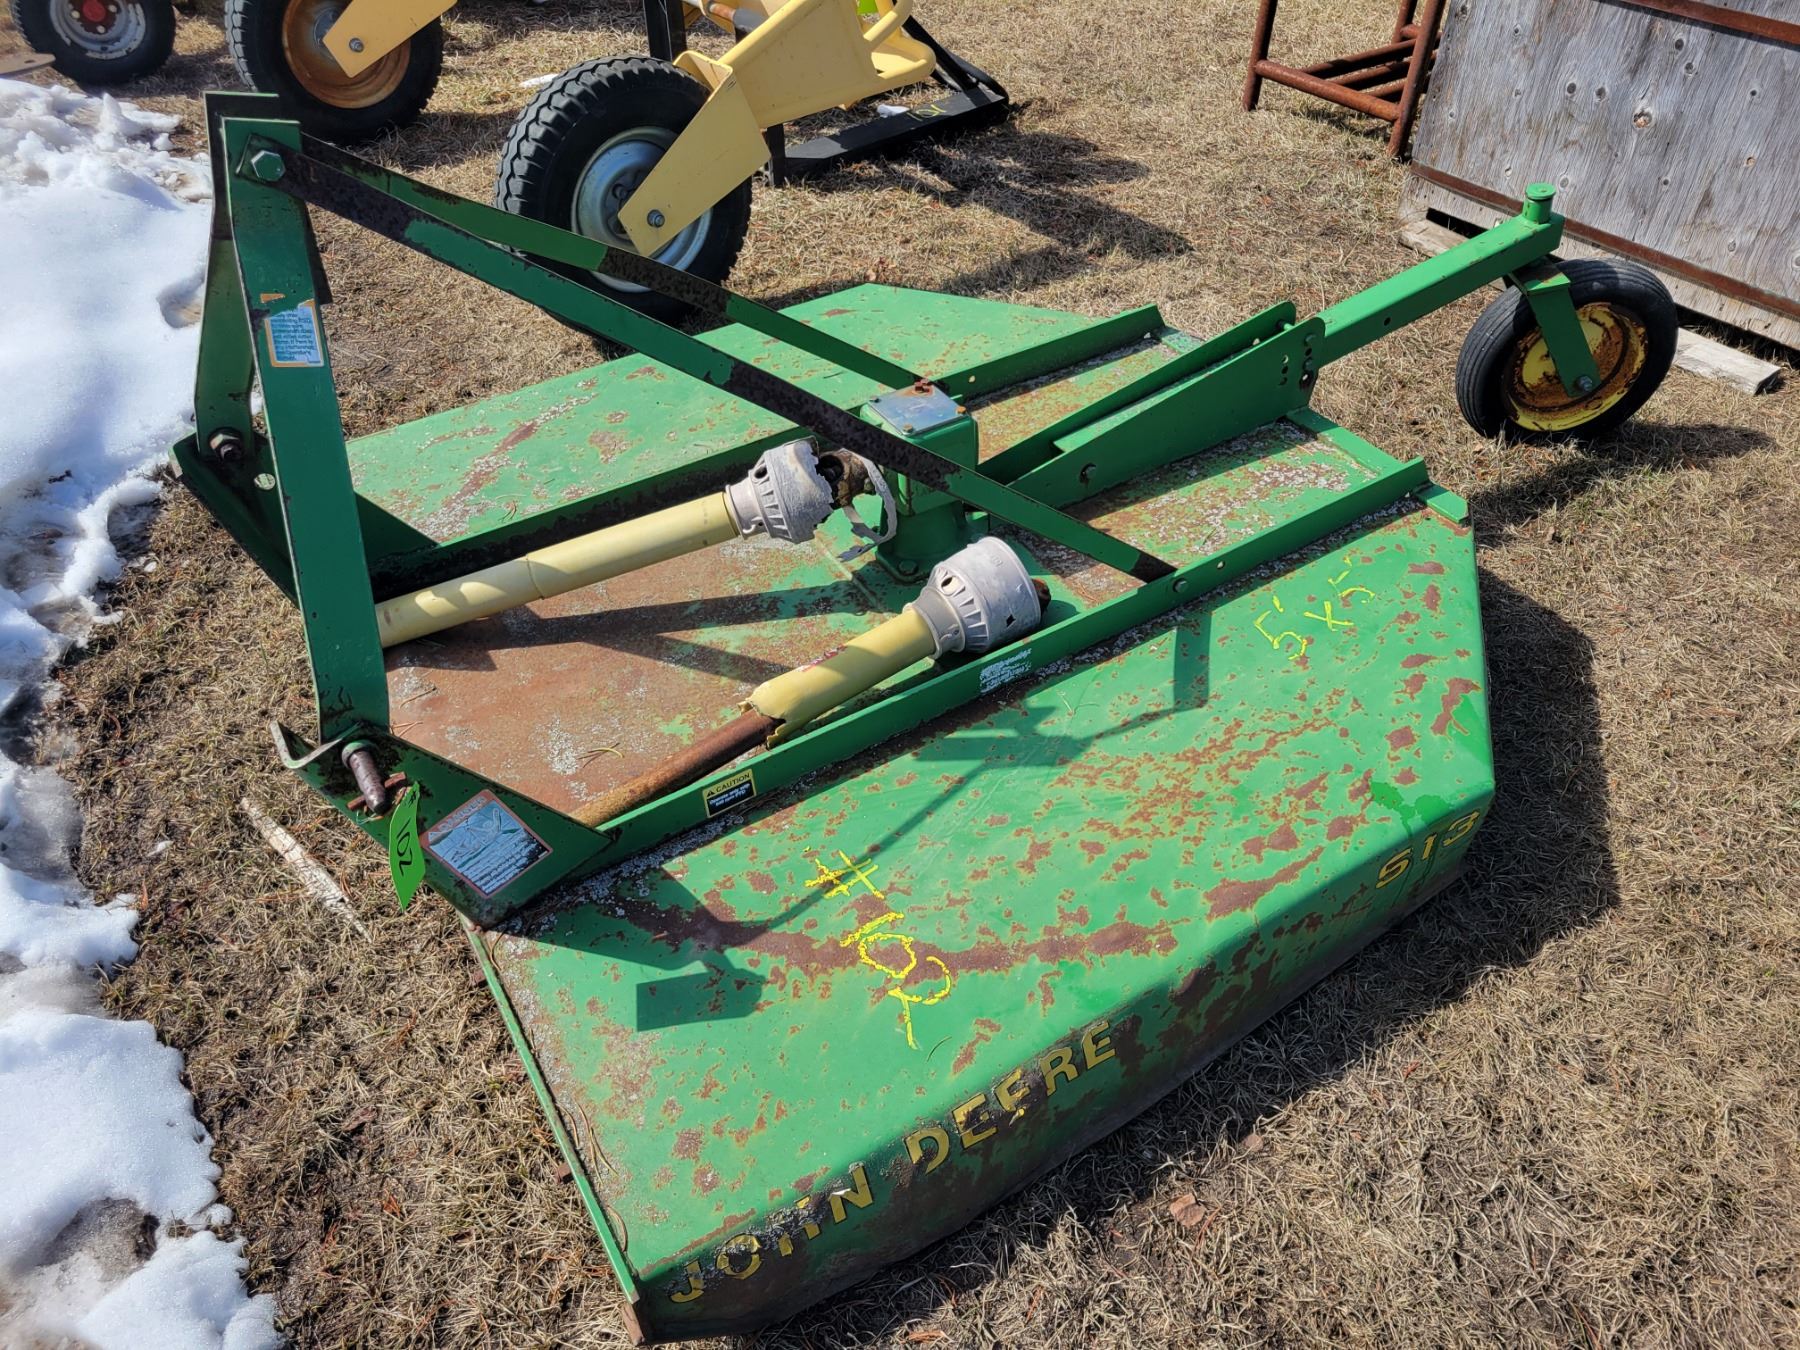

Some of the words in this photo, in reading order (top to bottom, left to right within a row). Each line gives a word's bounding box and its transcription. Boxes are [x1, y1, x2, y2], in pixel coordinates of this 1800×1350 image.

[716, 773, 750, 792] CAUTION
[1375, 811, 1481, 889] 513
[903, 1020, 1117, 1176] DEERE
